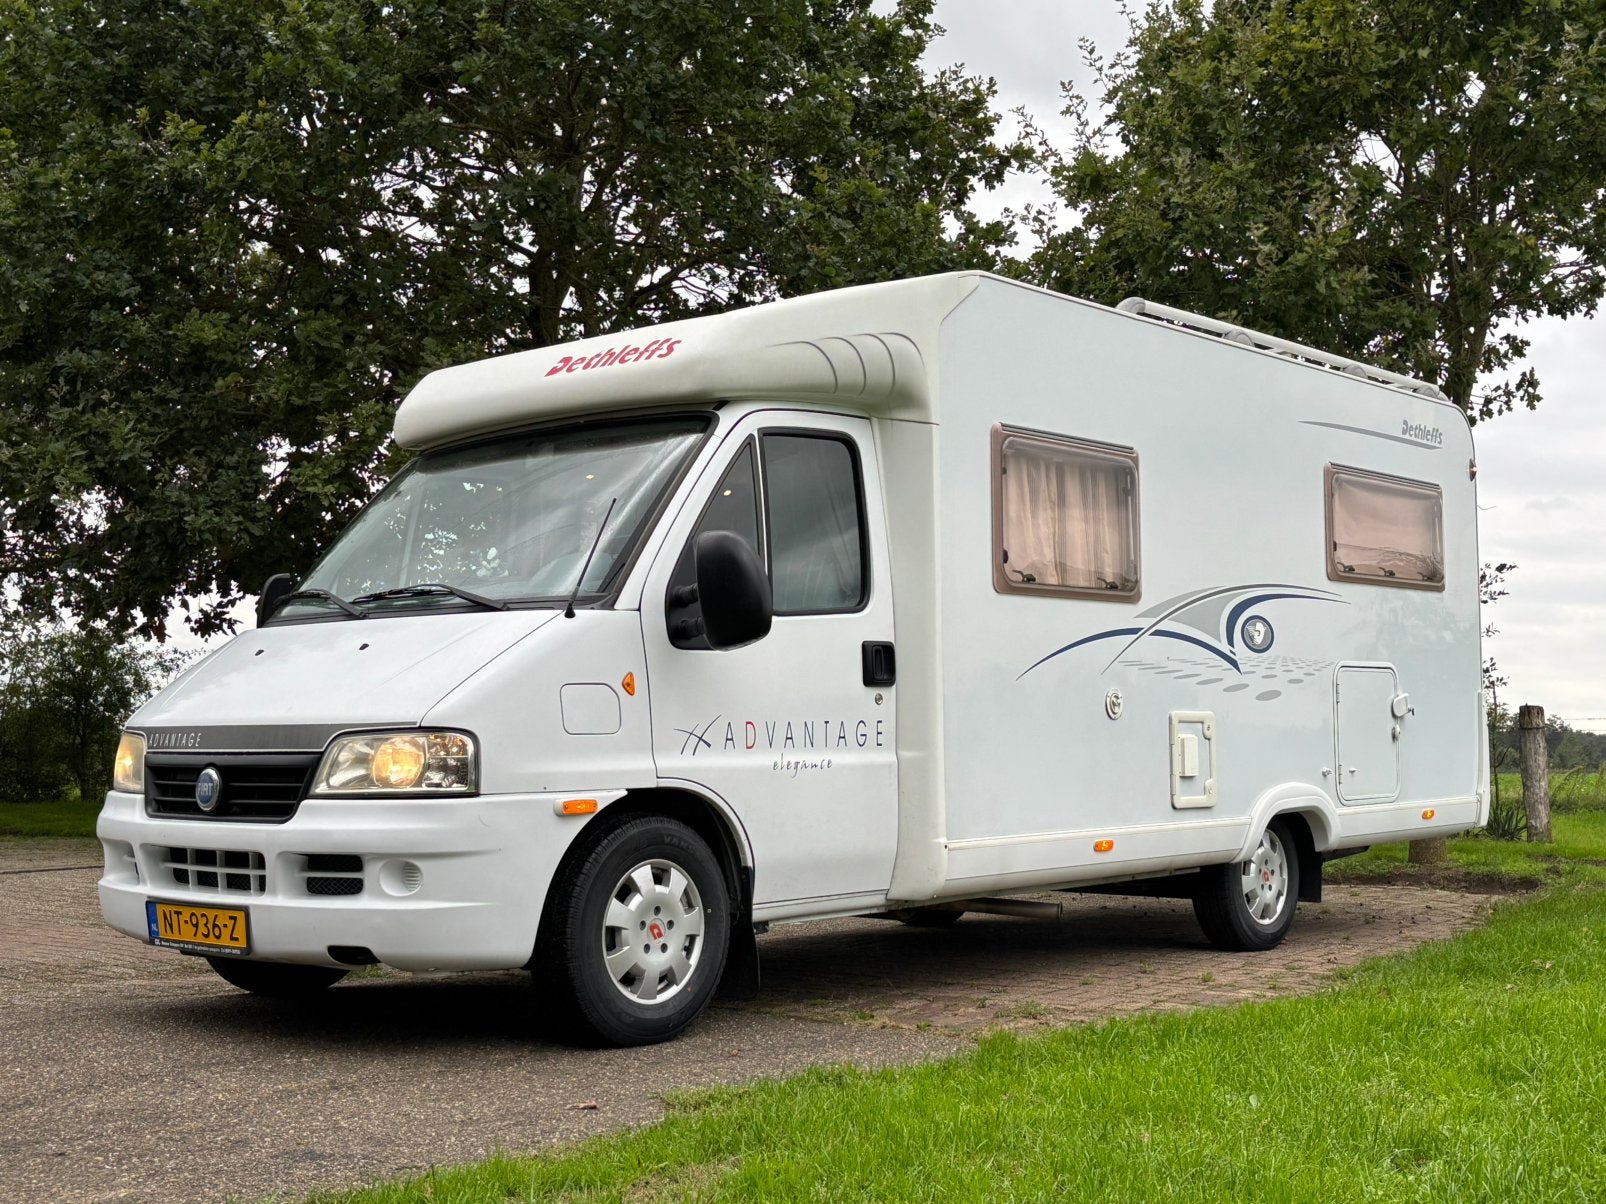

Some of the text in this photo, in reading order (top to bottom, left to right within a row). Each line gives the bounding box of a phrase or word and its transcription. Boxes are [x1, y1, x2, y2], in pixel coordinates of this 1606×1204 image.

[544, 337, 682, 377] Dethleffs
[1401, 419, 1443, 445] Dethleffs
[148, 732, 202, 747] ADVANTAGE
[724, 720, 883, 750] ADVANTAGE
[772, 752, 833, 778] elegance
[198, 782, 213, 796] FIAT
[151, 909, 240, 941] NL NT-936-Z
